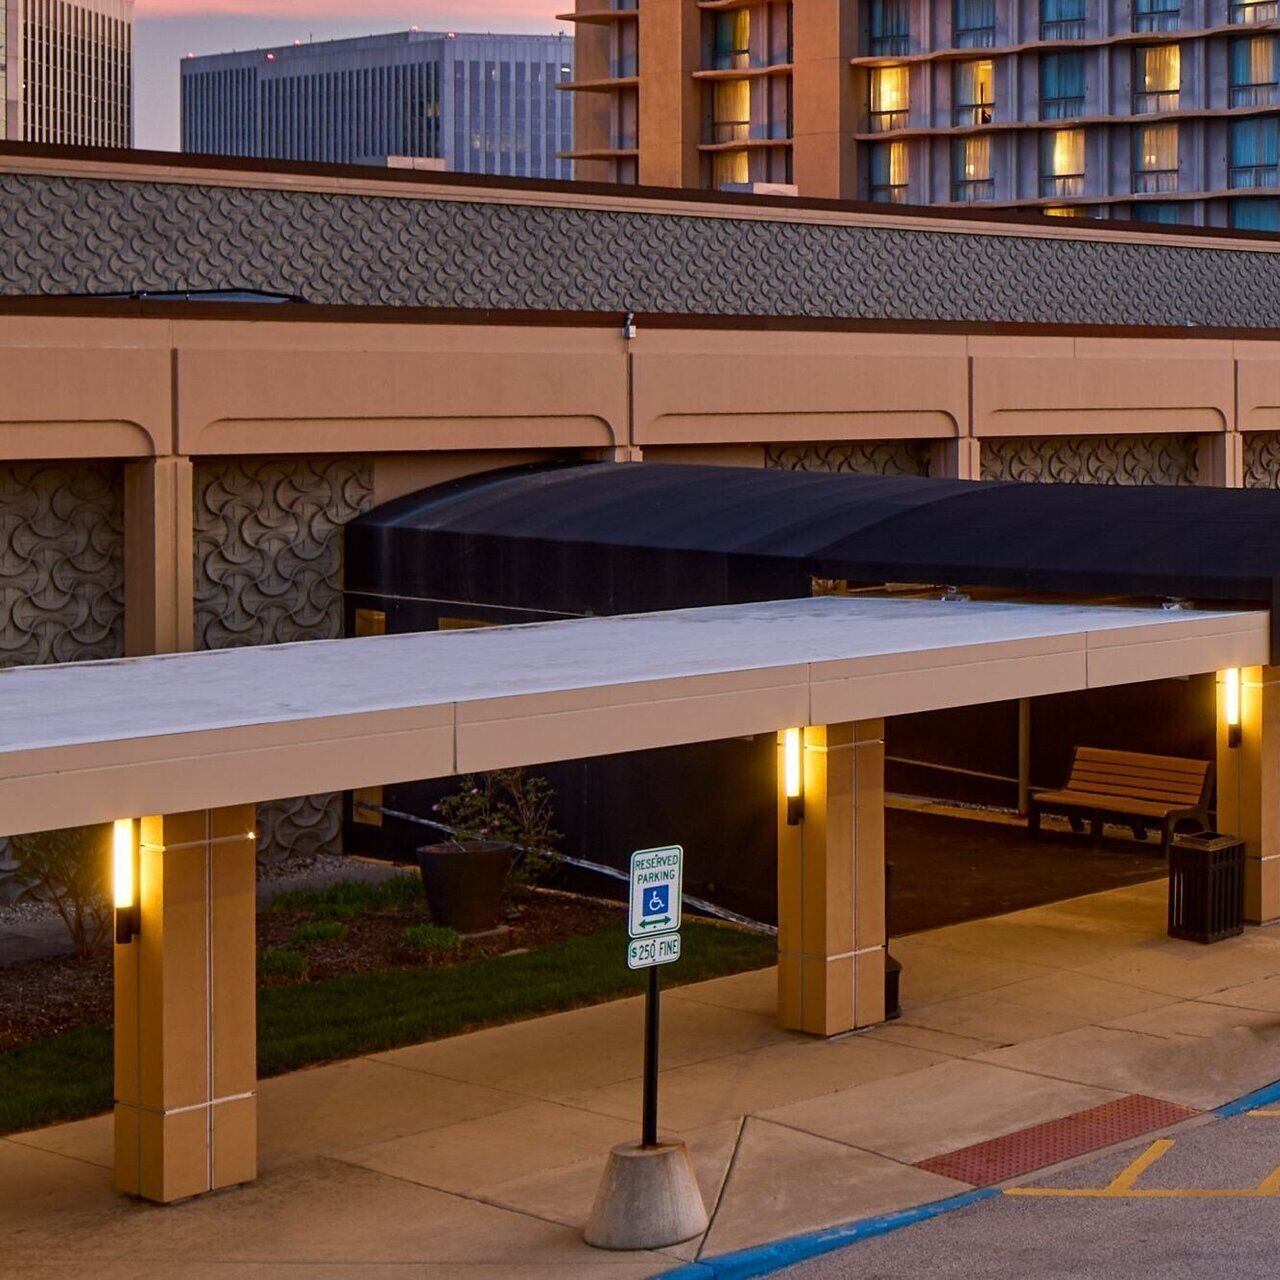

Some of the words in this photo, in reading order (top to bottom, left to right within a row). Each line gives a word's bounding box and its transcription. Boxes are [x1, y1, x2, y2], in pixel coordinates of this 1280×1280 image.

[634, 854, 678, 871] RESERVED
[637, 869, 675, 884] PARKING
[659, 939, 678, 956] FINE
